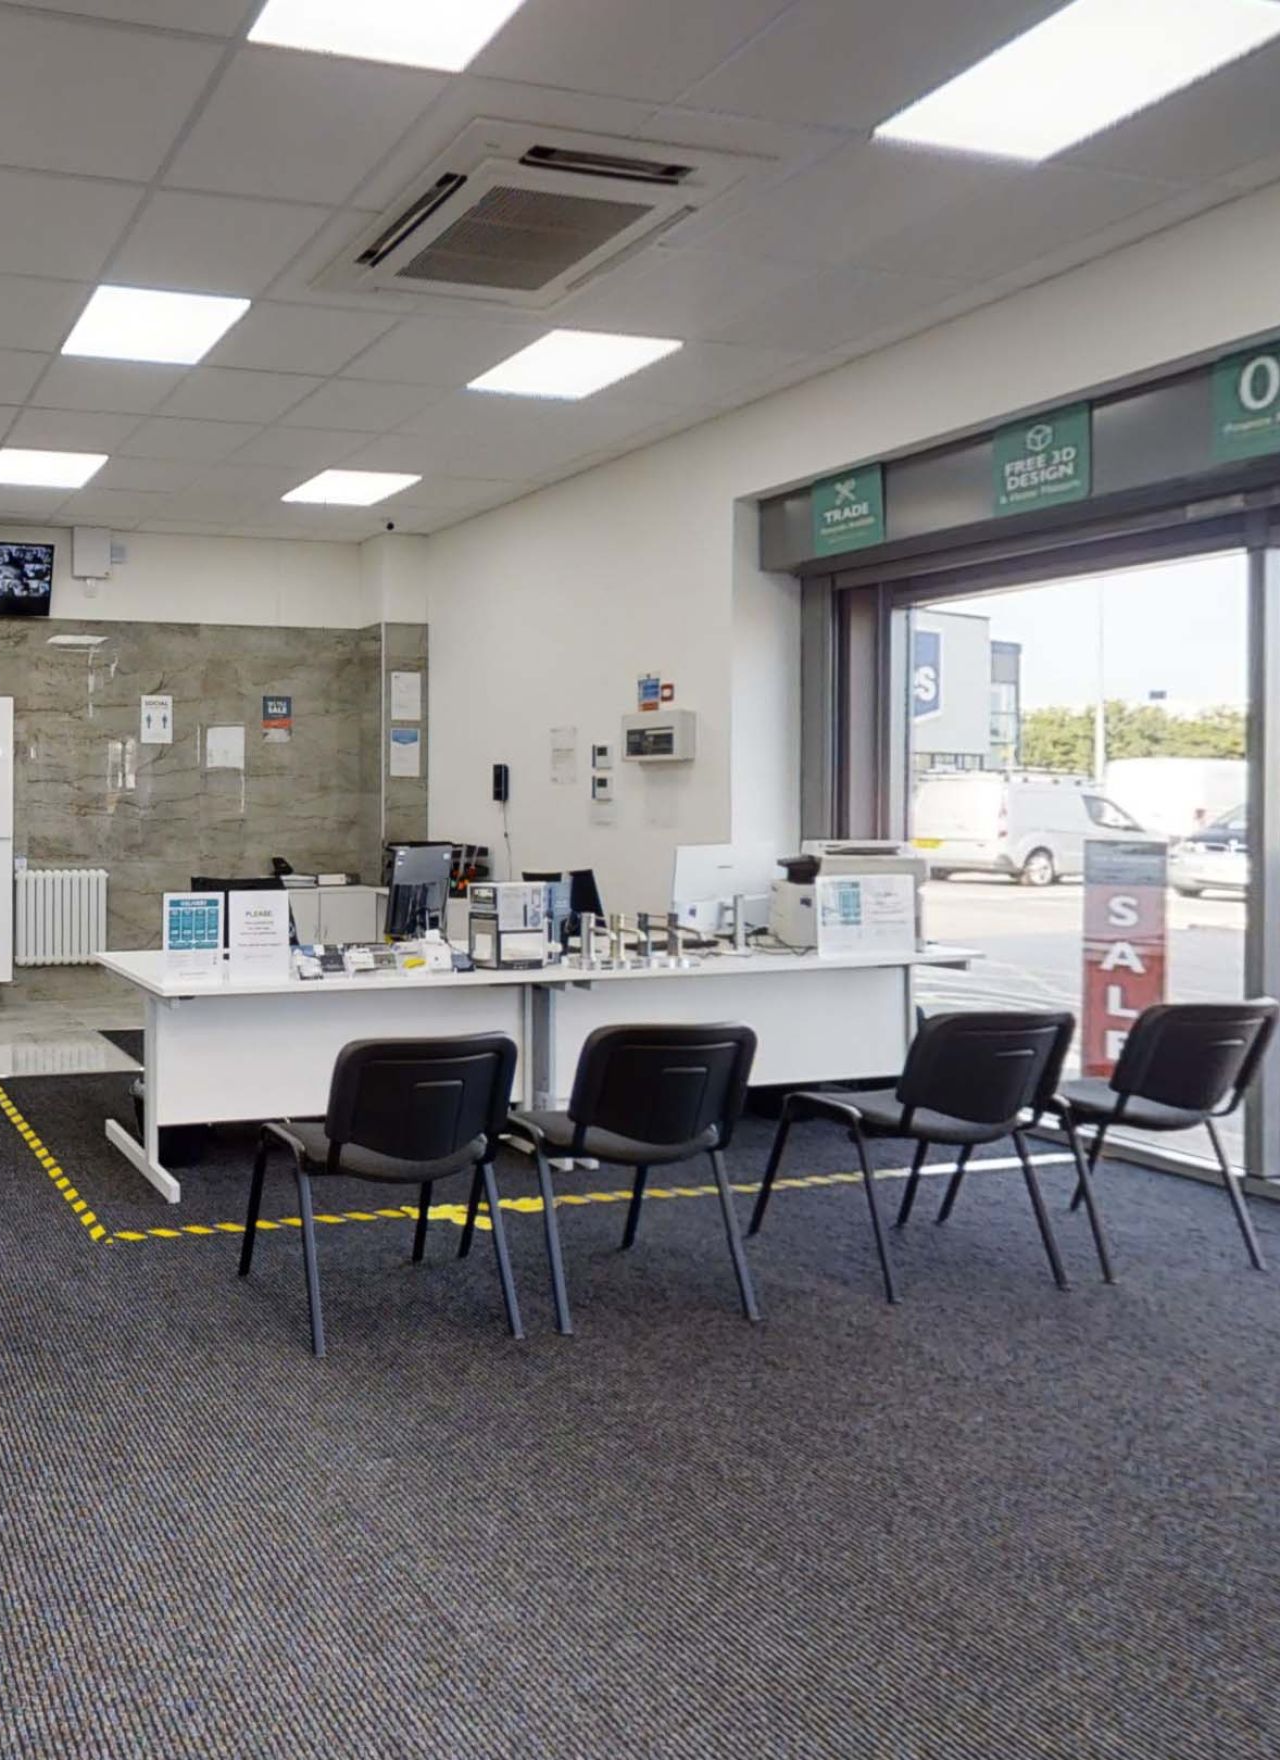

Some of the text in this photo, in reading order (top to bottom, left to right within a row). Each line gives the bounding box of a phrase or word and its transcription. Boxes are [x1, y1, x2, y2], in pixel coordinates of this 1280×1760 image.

[1004, 446, 1077, 477] FREE 3D
[1006, 461, 1075, 492] DESIGN
[823, 501, 870, 525] TRADE
